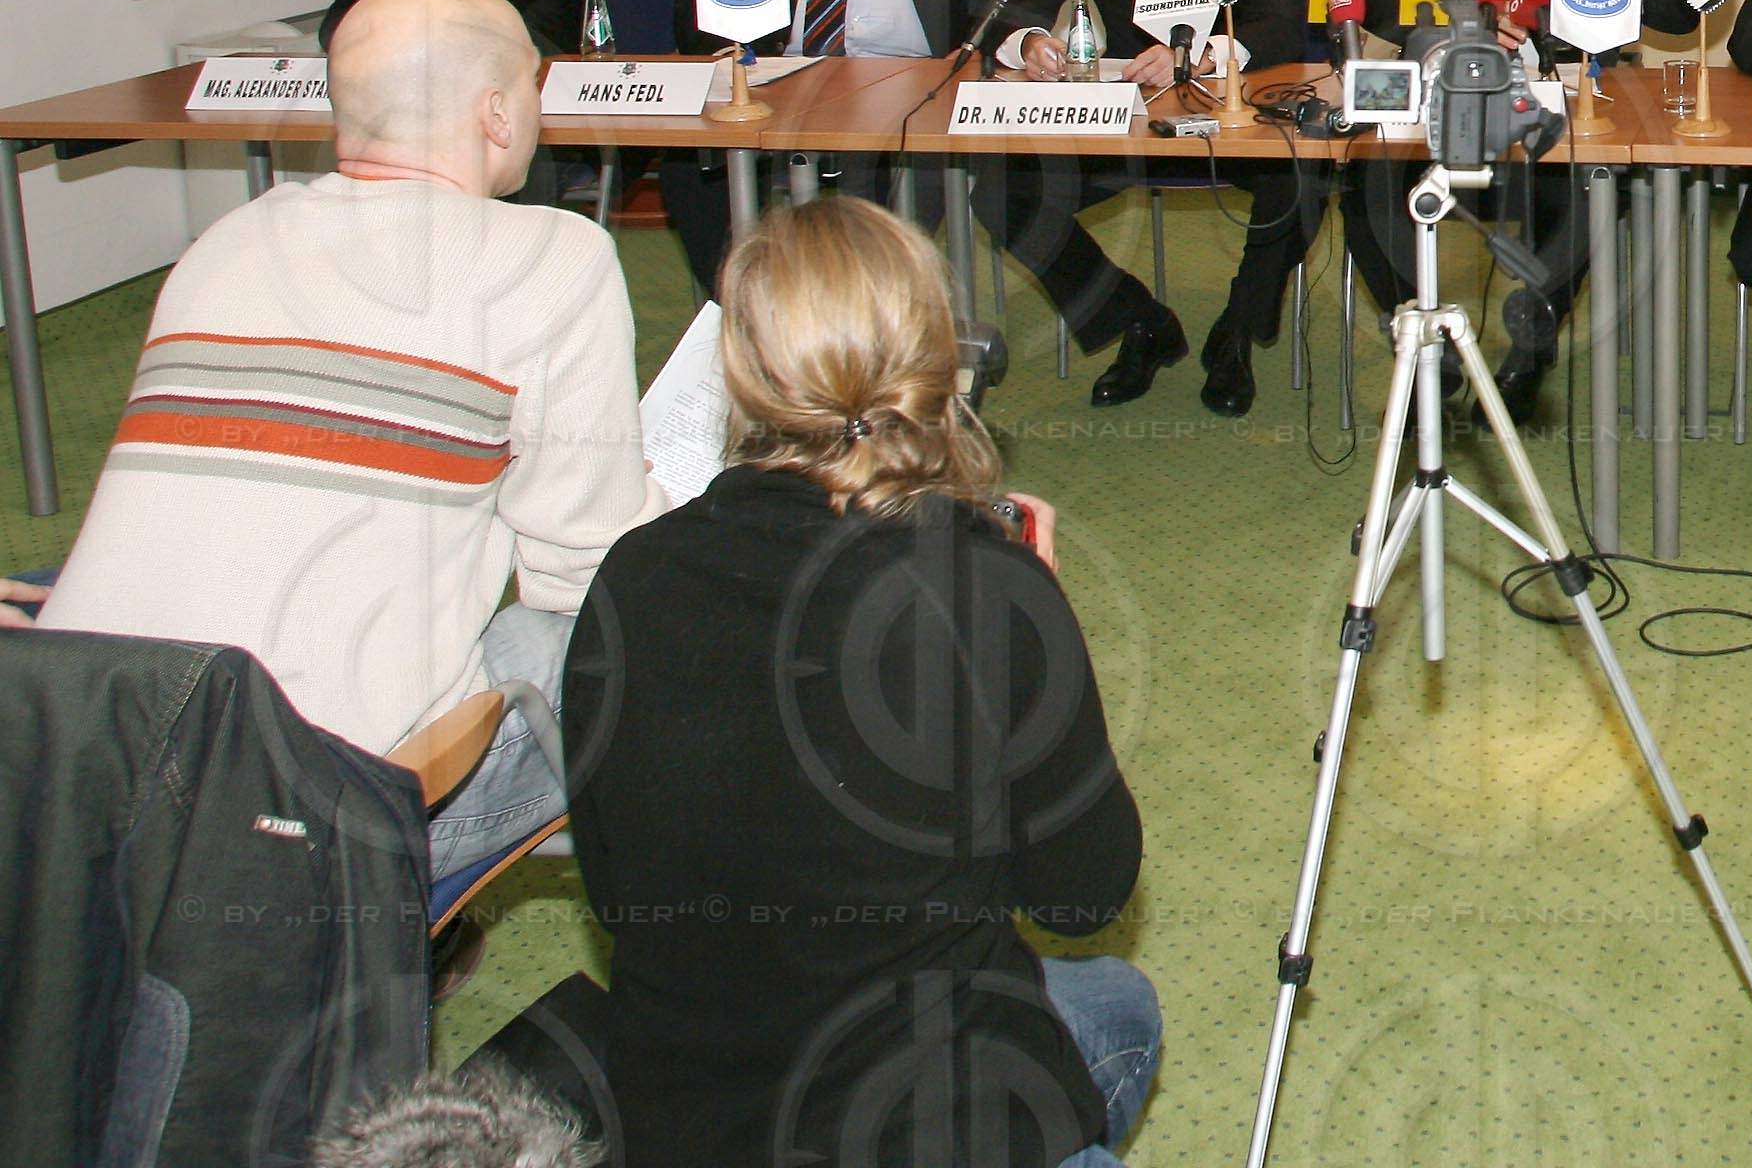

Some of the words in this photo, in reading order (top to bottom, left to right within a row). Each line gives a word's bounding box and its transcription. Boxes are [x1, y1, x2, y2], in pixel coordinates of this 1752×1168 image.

[204, 80, 231, 98] MAG.
[234, 80, 302, 98] ALEXANDER
[578, 84, 623, 102] HANS
[626, 84, 665, 102] FEDL
[958, 106, 986, 124] DR.
[992, 106, 1010, 124] N.
[1017, 106, 1128, 124] SCHERBAUM
